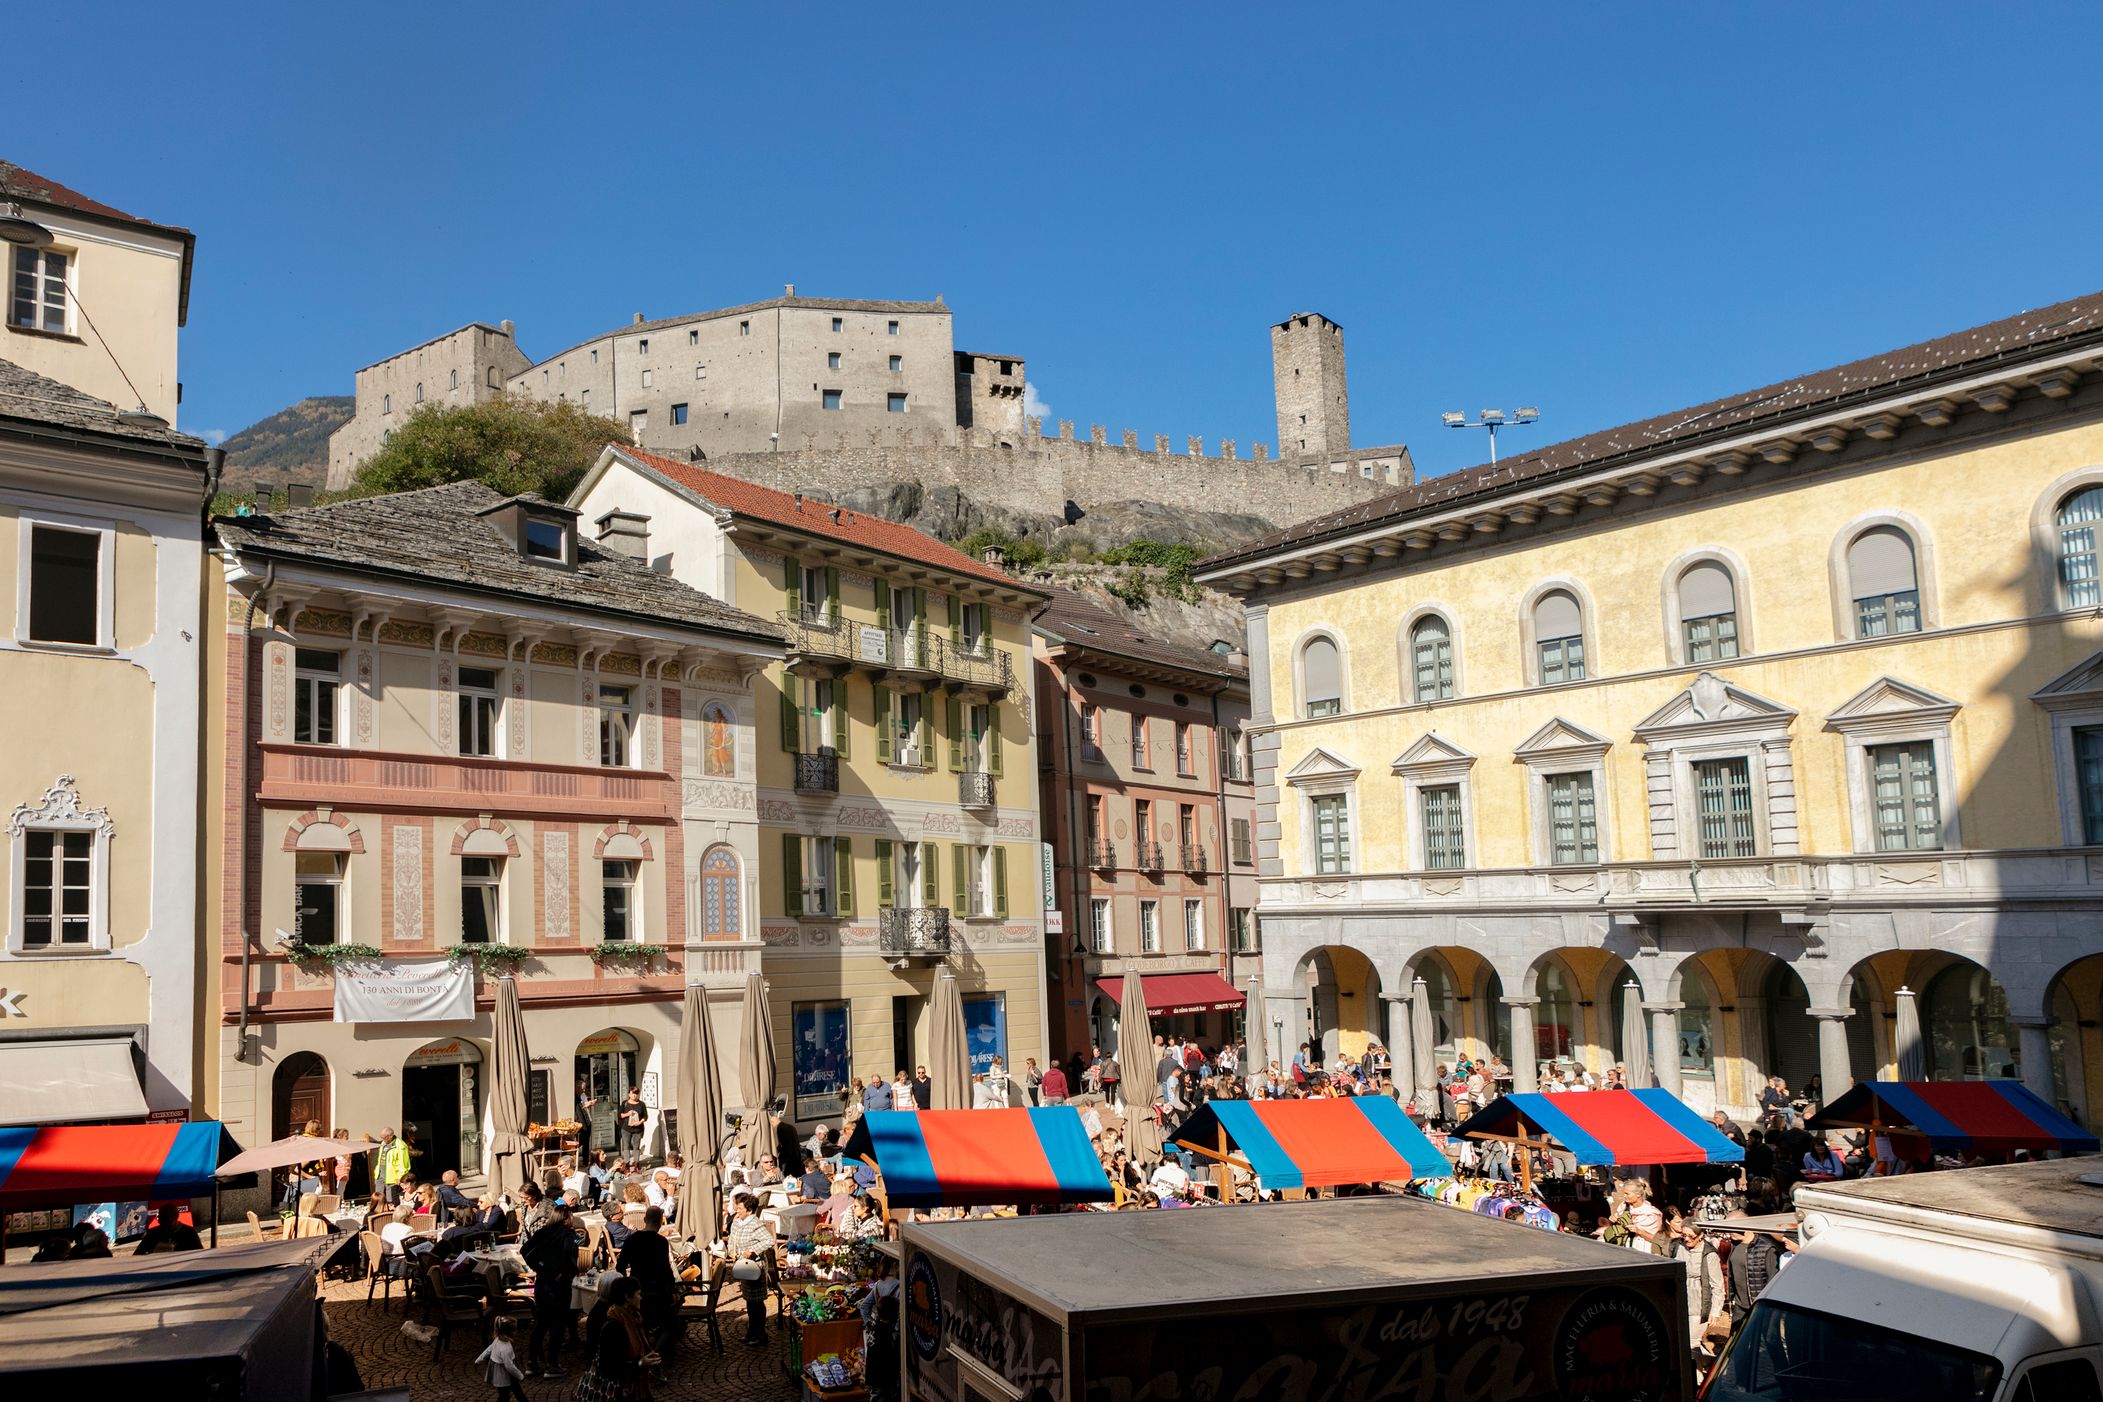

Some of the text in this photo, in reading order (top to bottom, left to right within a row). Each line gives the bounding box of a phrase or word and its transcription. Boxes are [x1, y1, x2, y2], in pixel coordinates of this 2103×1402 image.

[295, 885, 303, 906] BAR
[362, 983, 449, 995] 130 ANNI DI BONTÀ
[1379, 1294, 1531, 1342] dal 1948
[1564, 1301, 1607, 1373] MACELLERIA
[1619, 1299, 1661, 1363] SALUMERIA
